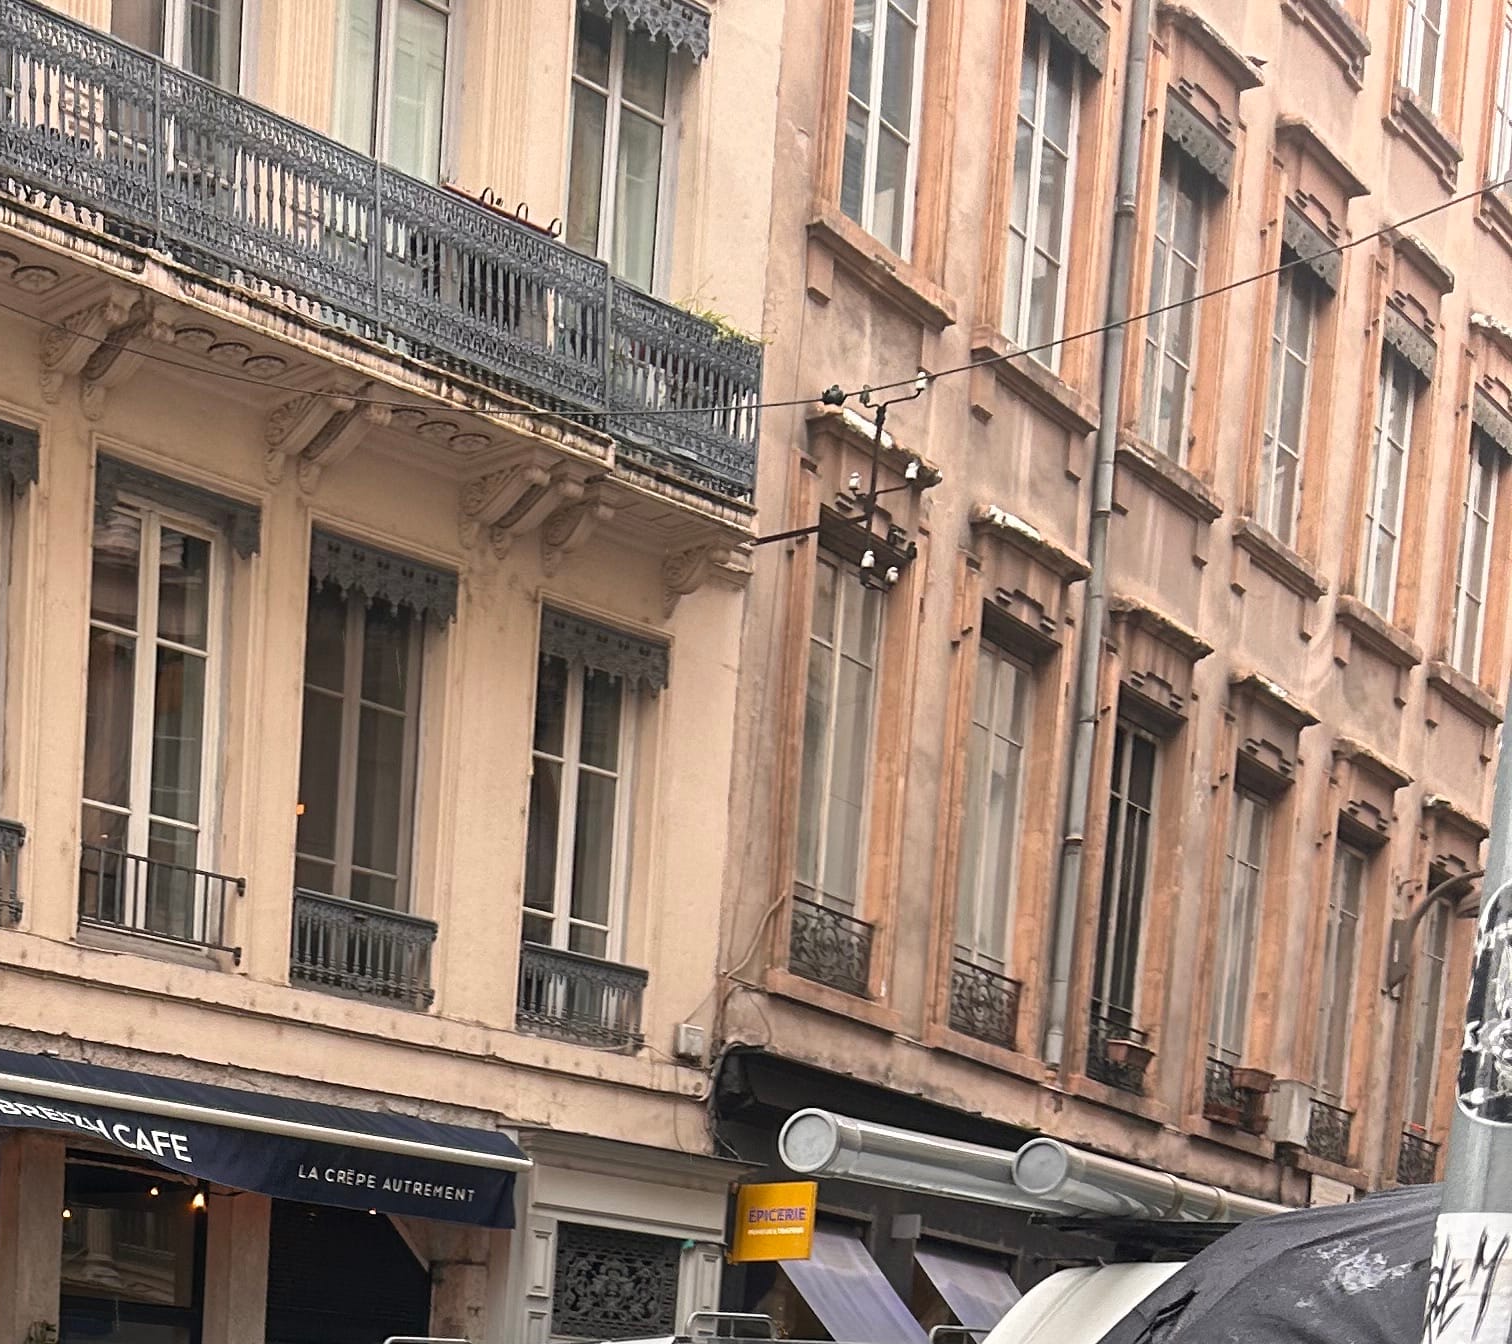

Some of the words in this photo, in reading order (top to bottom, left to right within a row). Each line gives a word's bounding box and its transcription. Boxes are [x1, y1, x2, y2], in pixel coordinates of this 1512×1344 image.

[112, 1123, 193, 1163] CAFE
[298, 1164, 319, 1180] LA
[324, 1167, 377, 1189] CRÊPE
[382, 1176, 476, 1202] AUTREMENT
